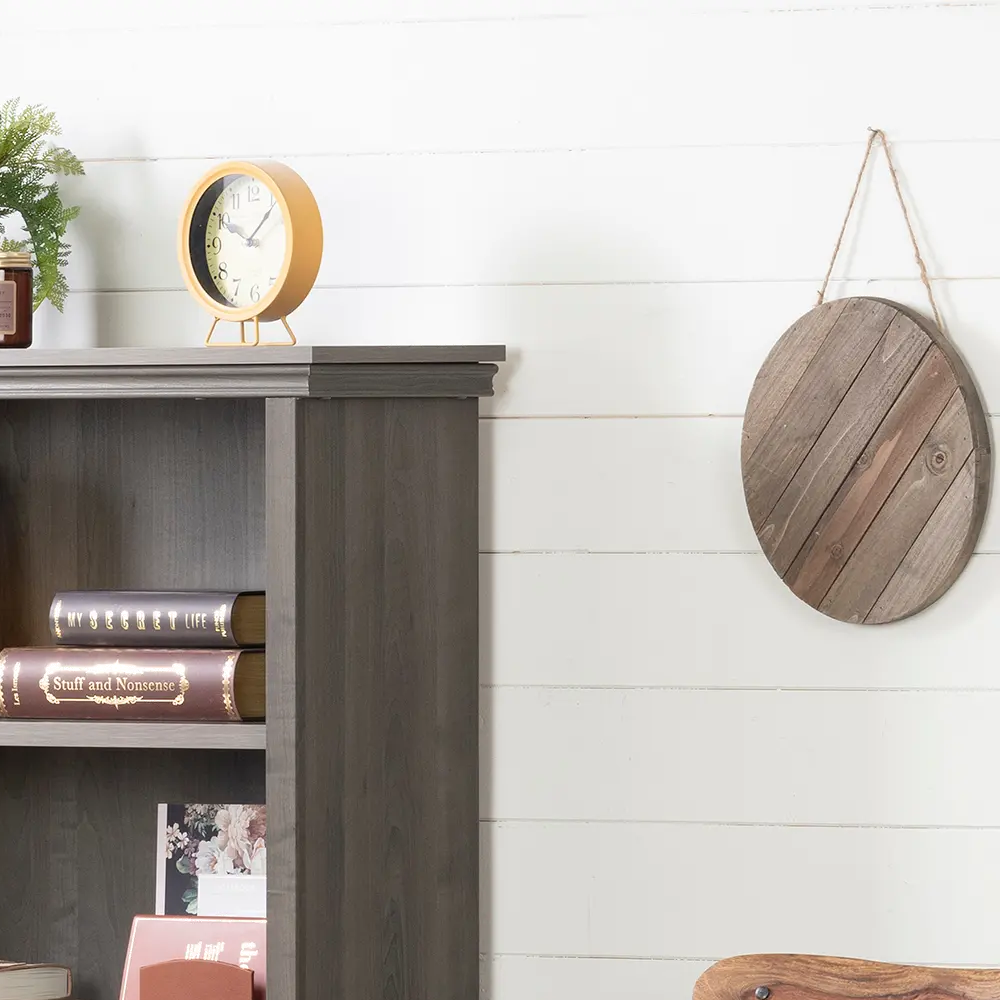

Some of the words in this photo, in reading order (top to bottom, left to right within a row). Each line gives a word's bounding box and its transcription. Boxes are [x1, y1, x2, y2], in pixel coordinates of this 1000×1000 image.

[232, 193, 240, 210] 11
[247, 185, 260, 203] 12
[218, 212, 230, 230] 10
[212, 236, 222, 255] 9
[218, 261, 228, 280] 8
[232, 278, 242, 297] 7
[250, 284, 260, 304] 6
[67, 612, 83, 628] MY
[89, 610, 177, 630] SECRET
[185, 612, 207, 629] LIFE
[53, 676, 85, 691] Stuff
[88, 677, 112, 691] and
[115, 677, 176, 692] Nonsense
